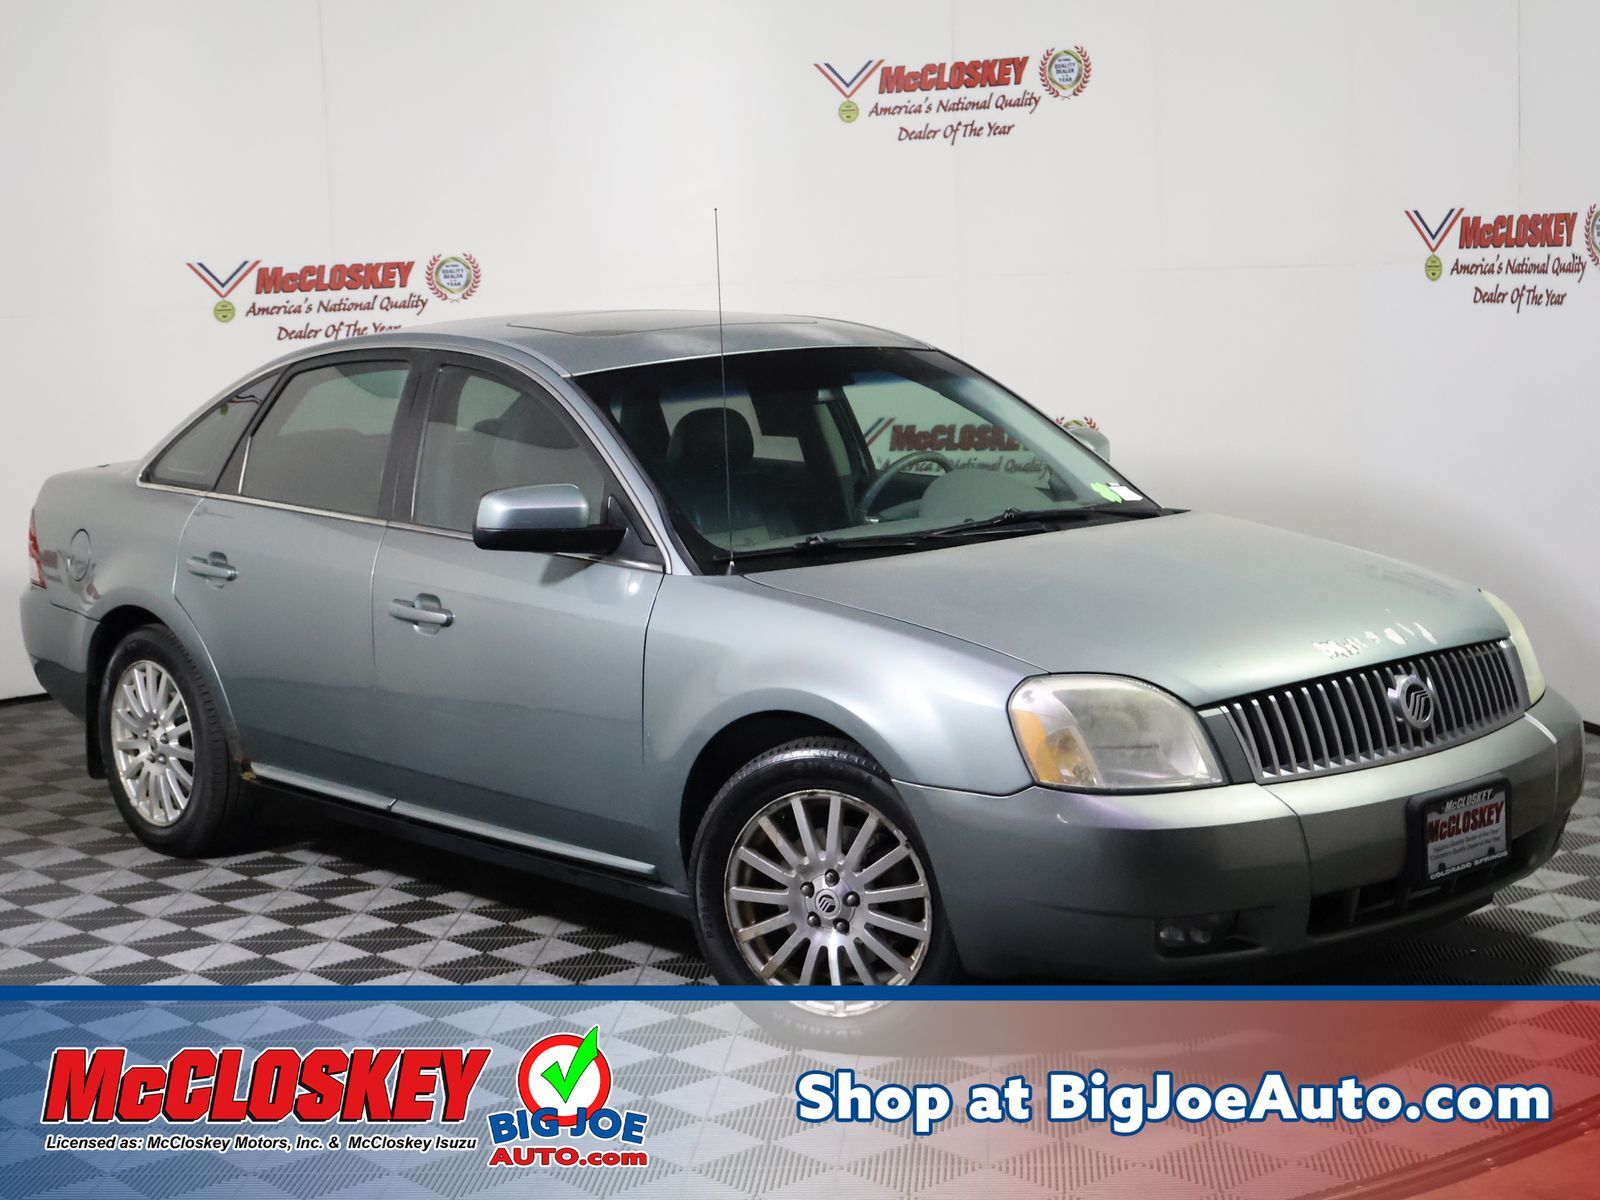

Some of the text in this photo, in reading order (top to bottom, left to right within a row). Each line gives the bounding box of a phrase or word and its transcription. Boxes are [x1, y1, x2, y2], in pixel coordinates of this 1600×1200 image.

[879, 56, 1030, 95] McCLOSKEY
[868, 97, 932, 117] America's
[936, 93, 992, 113] National
[995, 90, 1041, 115] Quality
[897, 121, 1015, 146] Dealer Of The Year
[1458, 212, 1578, 249] McCLOSKEY
[255, 261, 415, 294] McCLOSKEY
[1450, 254, 1502, 276] America's
[1505, 253, 1550, 275] National
[1552, 253, 1587, 283] Quality
[245, 298, 313, 317] America's
[317, 295, 376, 313] National
[379, 293, 428, 316] Quality
[1473, 284, 1567, 313] Dealer Of The Year
[277, 322, 322, 340] Dealer
[325, 321, 344, 340] Of
[345, 320, 368, 337] The
[1444, 789, 1493, 811] McCLOSKEY
[1426, 801, 1505, 844] McCLOSKEY
[1430, 850, 1508, 880] COLORADO SPRINGS
